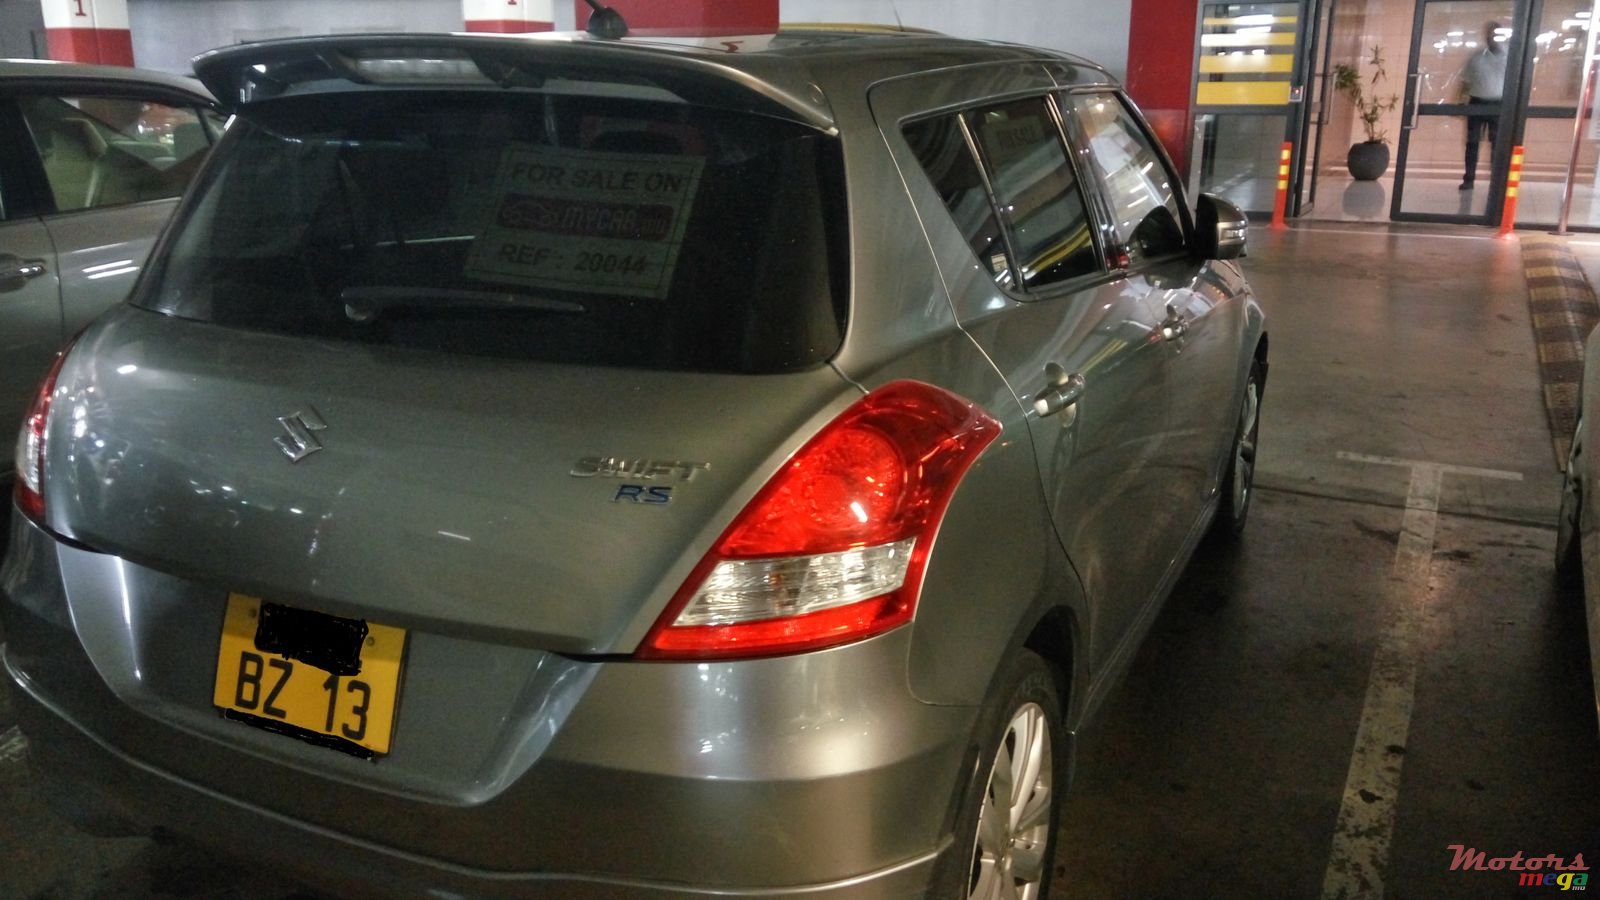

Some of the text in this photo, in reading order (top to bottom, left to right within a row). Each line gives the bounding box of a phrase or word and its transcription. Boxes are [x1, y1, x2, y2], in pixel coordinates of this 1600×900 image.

[511, 161, 681, 193] FOR SALE ON
[501, 243, 550, 265] REF
[573, 251, 648, 275] 20044
[570, 456, 712, 481] SWIFT
[613, 484, 673, 505] RS
[235, 651, 372, 741] BZ 13
